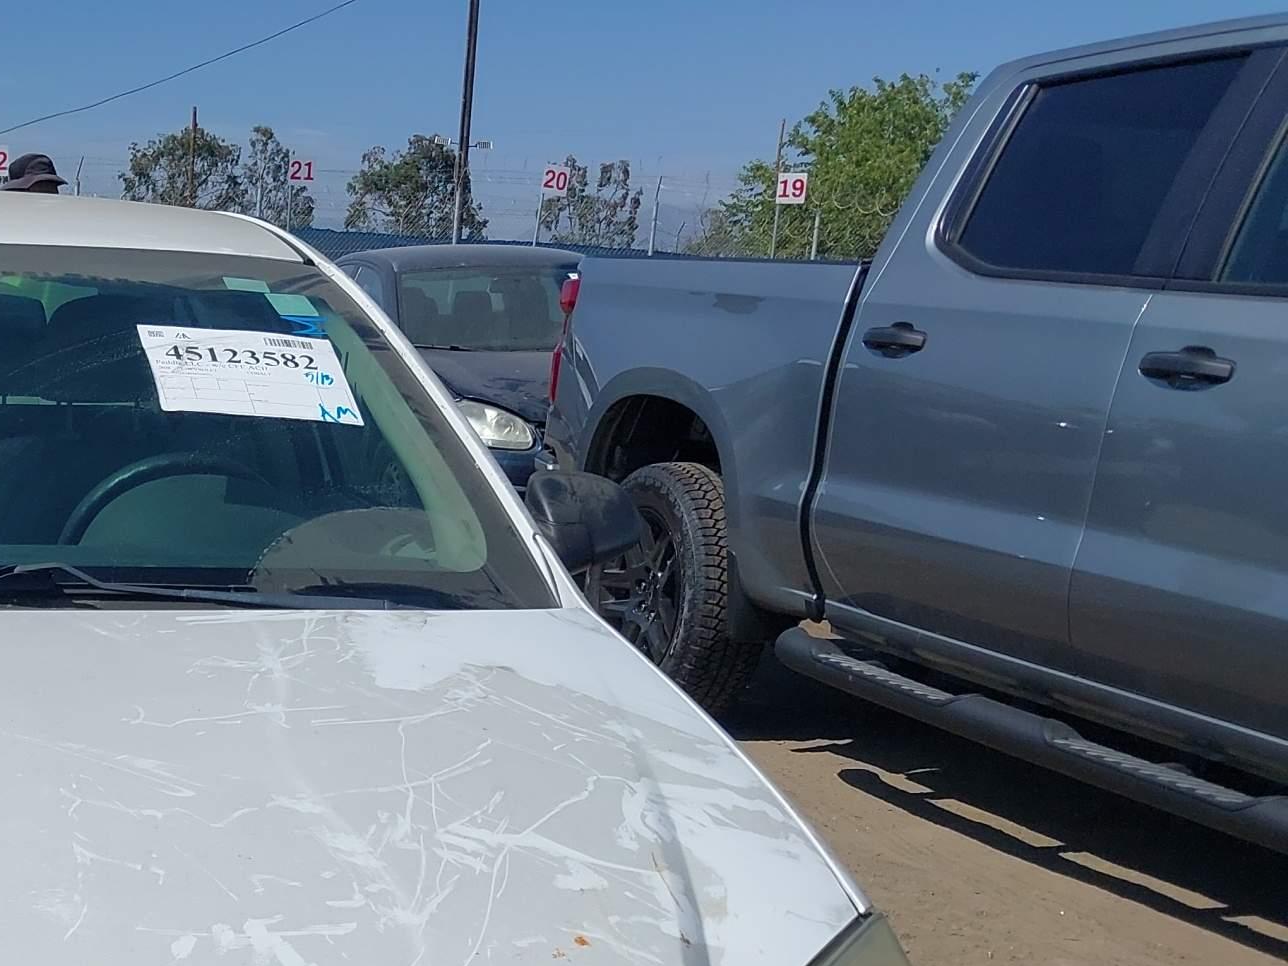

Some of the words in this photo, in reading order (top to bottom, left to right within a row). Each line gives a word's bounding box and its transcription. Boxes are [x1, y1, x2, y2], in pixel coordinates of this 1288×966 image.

[289, 160, 314, 181] 21
[543, 169, 568, 191] 20
[778, 178, 805, 199] 19
[165, 344, 319, 371] 45123582
